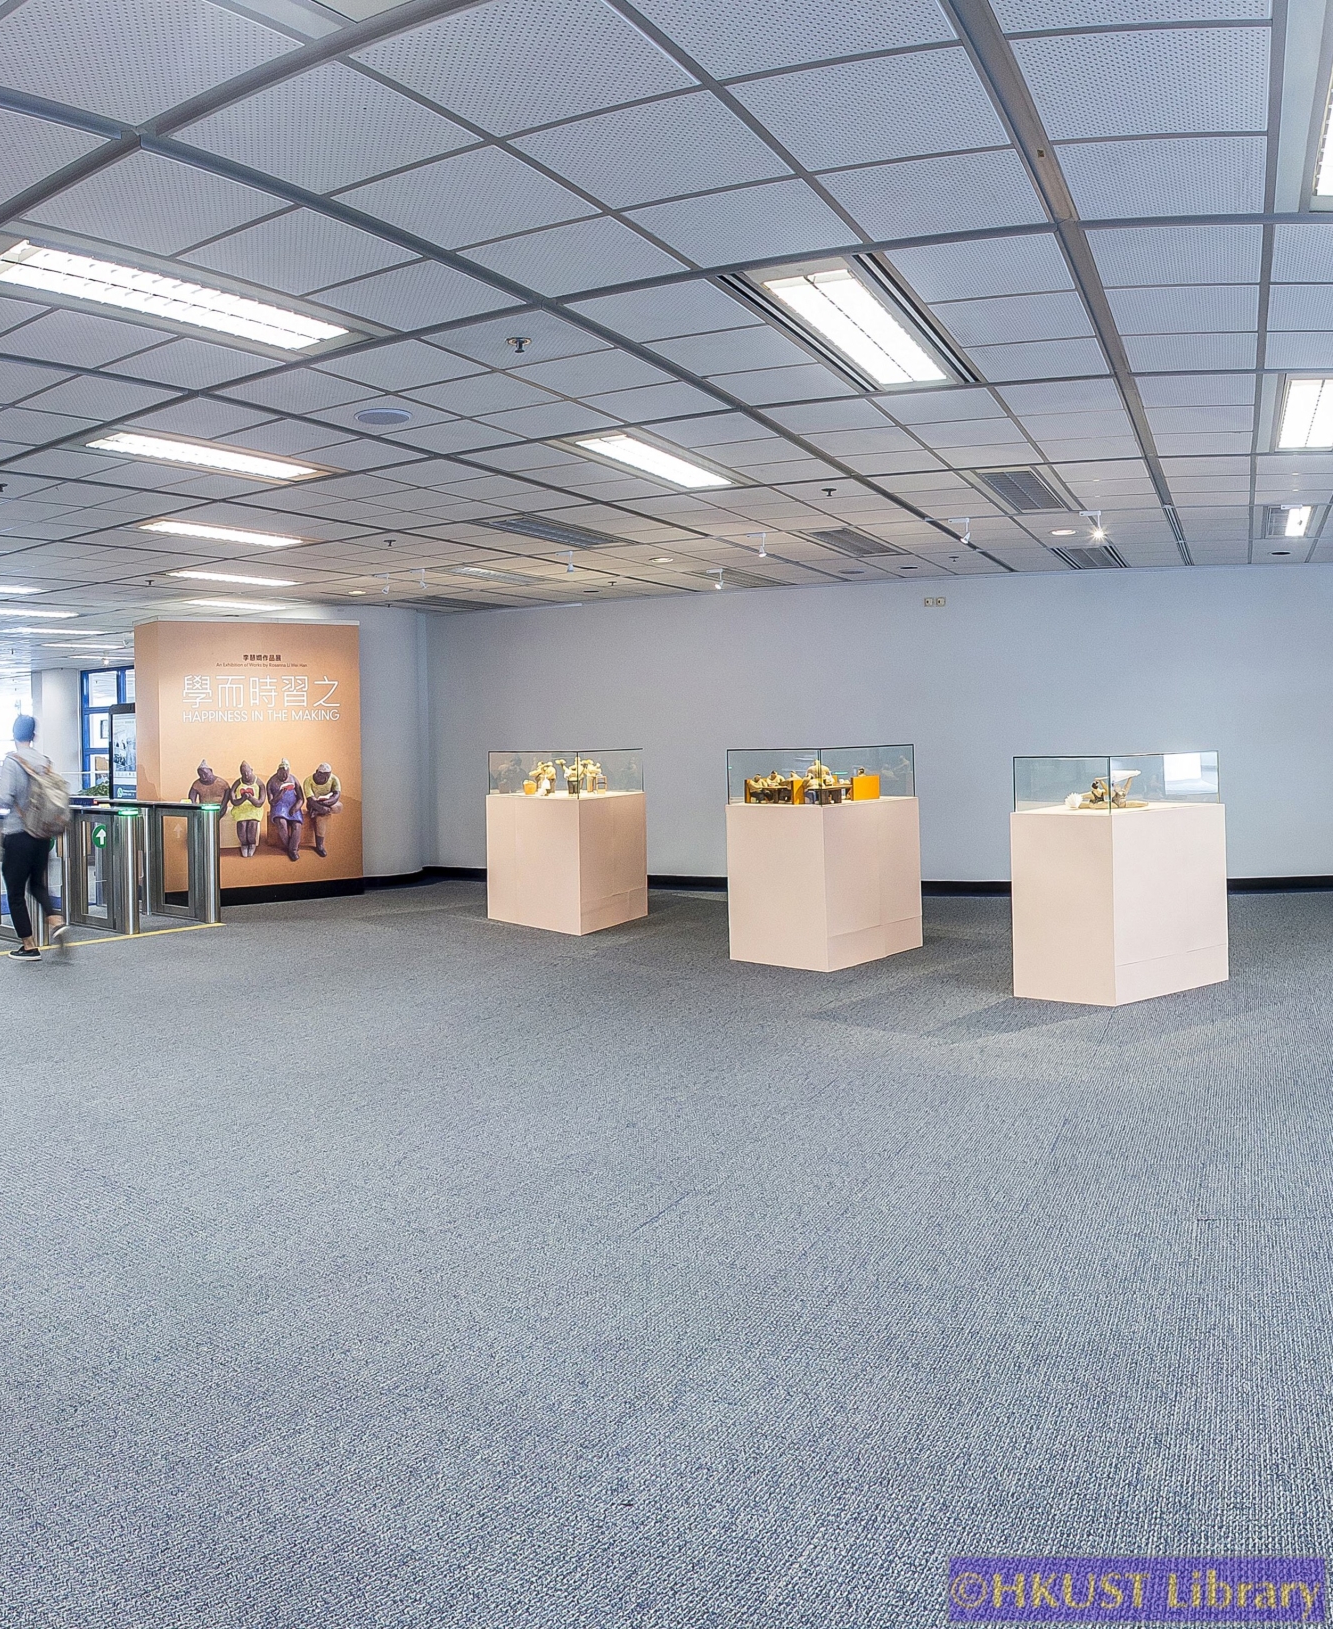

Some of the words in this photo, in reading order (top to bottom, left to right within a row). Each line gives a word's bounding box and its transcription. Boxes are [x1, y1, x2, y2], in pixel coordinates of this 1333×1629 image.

[183, 675, 340, 708] 學而時習之
[183, 710, 247, 722] HAPPINESS
[251, 710, 263, 721] IN
[267, 710, 287, 721] THE
[292, 710, 340, 721] MAKING
